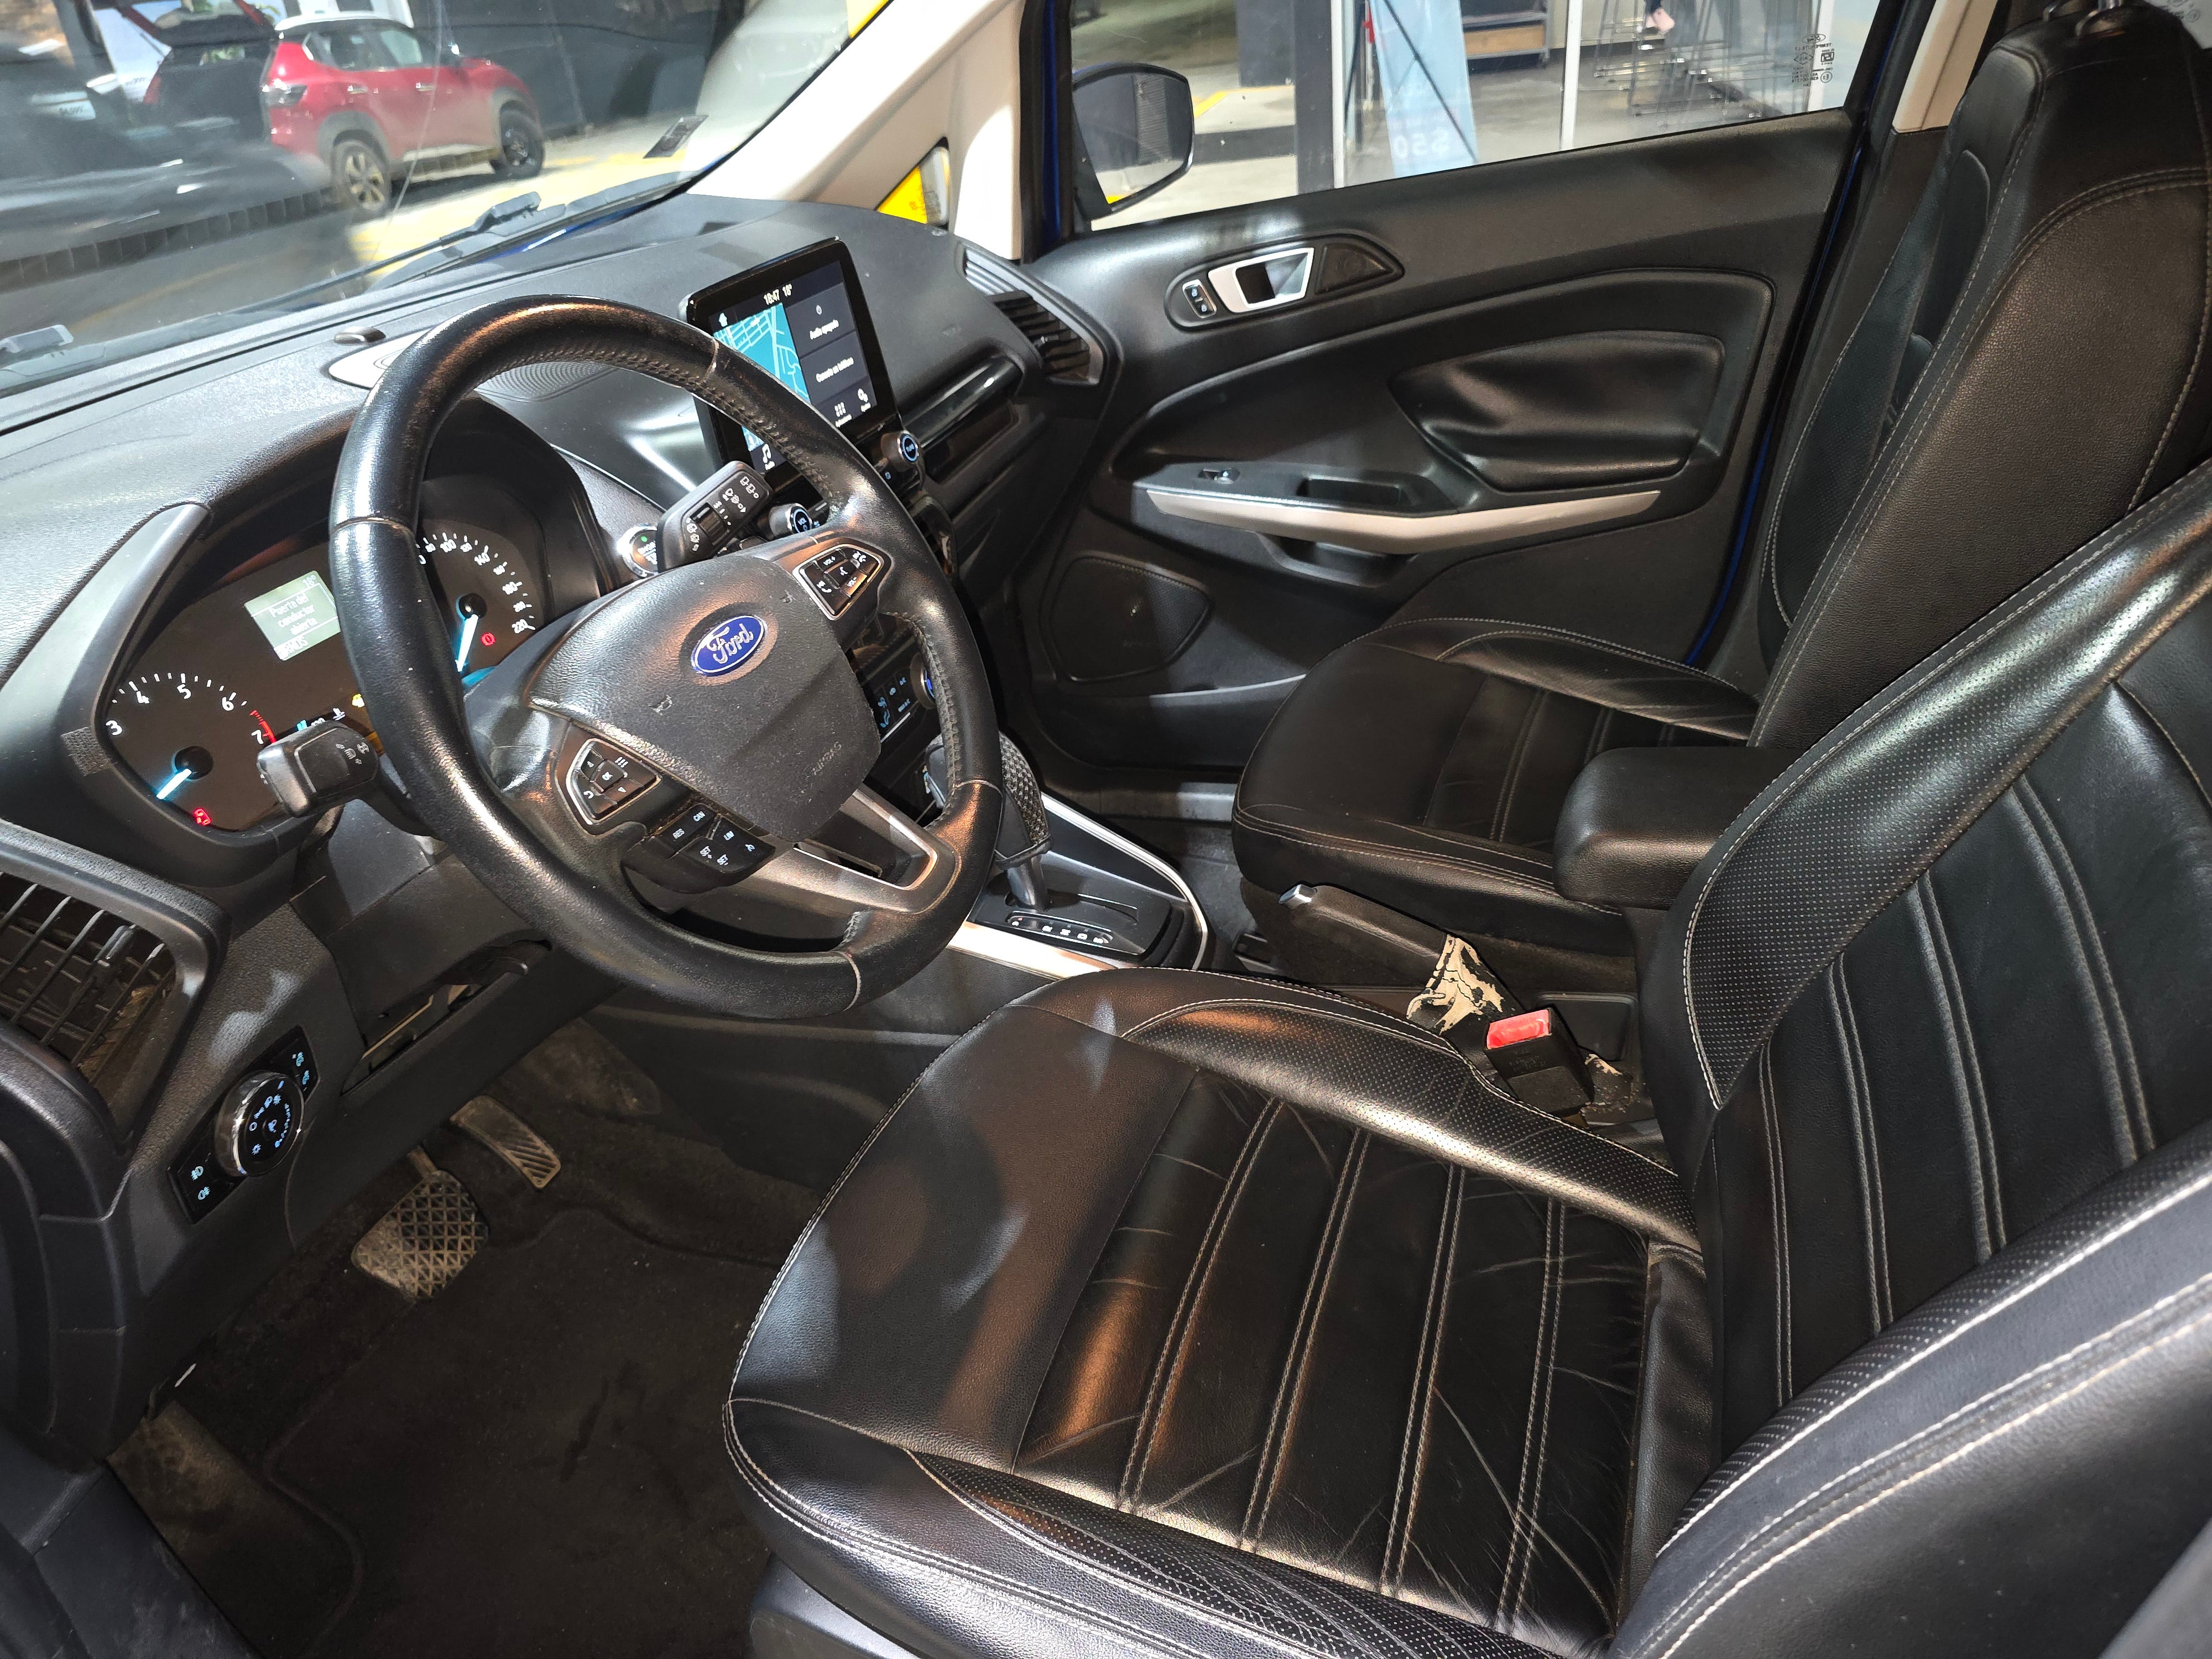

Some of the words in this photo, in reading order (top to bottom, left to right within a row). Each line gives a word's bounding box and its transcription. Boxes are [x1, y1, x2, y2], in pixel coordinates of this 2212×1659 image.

[764, 289, 780, 305] 18:47
[440, 539, 457, 552] 100
[474, 552, 491, 565] 140
[502, 581, 518, 594] 180
[268, 601, 298, 618] Puerta
[296, 592, 310, 605] del
[278, 604, 315, 628] conductor
[290, 618, 319, 635] abierta
[512, 619, 529, 634] 220
[706, 623, 754, 664] Ford
[136, 691, 150, 704] 4
[177, 684, 191, 699] 5
[222, 697, 234, 711] 6
[106, 720, 122, 735] 3
[251, 729, 264, 744] 7
